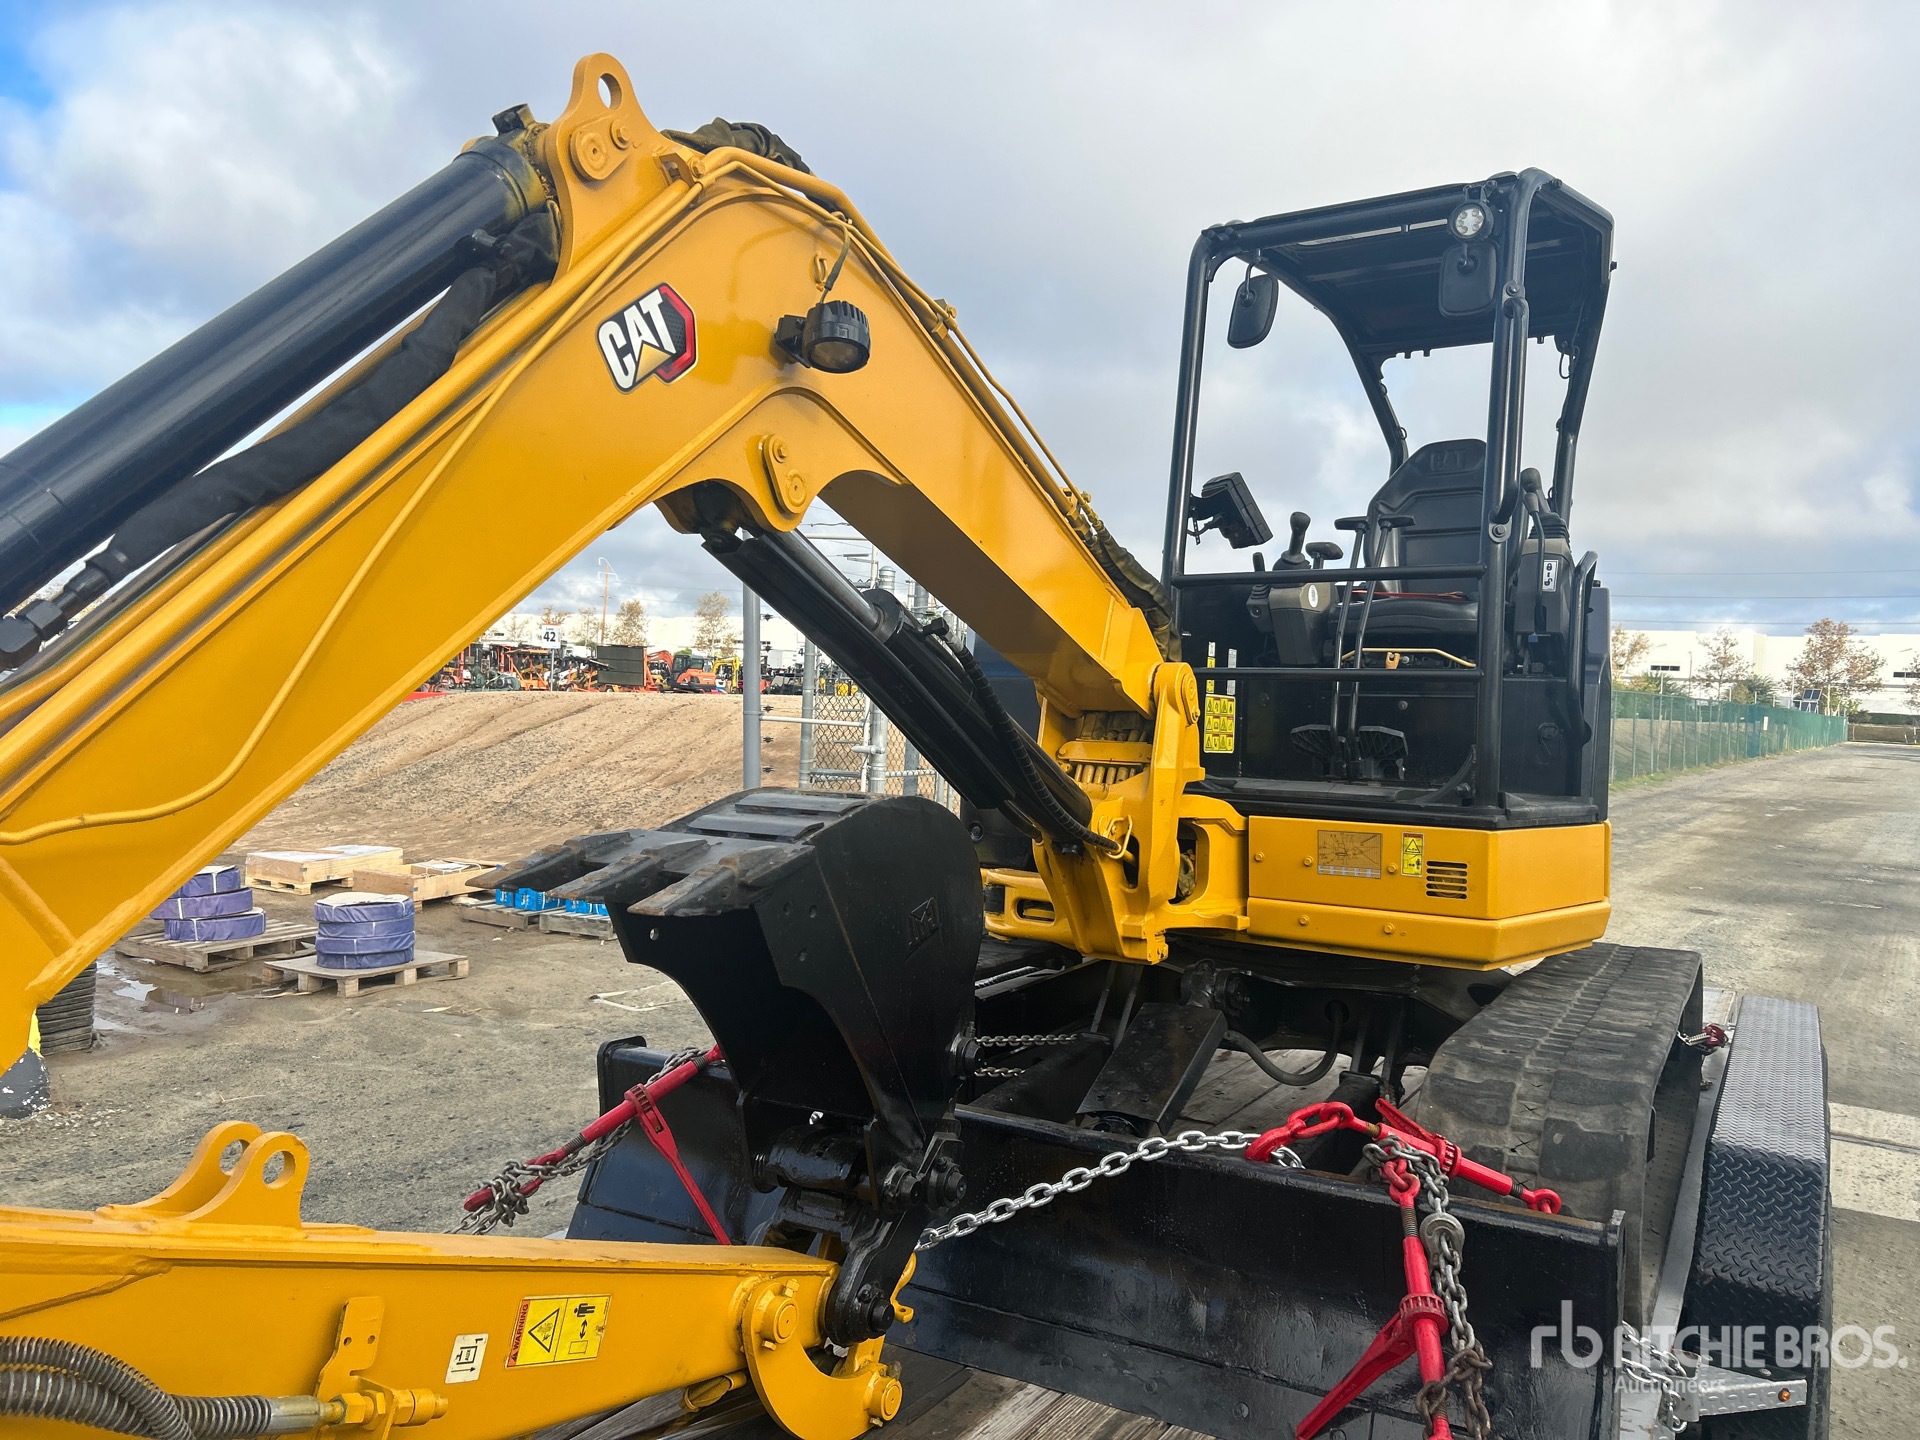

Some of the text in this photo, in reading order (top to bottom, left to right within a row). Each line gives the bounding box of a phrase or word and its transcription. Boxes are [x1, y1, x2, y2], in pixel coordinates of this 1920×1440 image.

[599, 289, 676, 388] CAT
[543, 631, 556, 642] 42
[513, 1303, 529, 1350] WARNING
